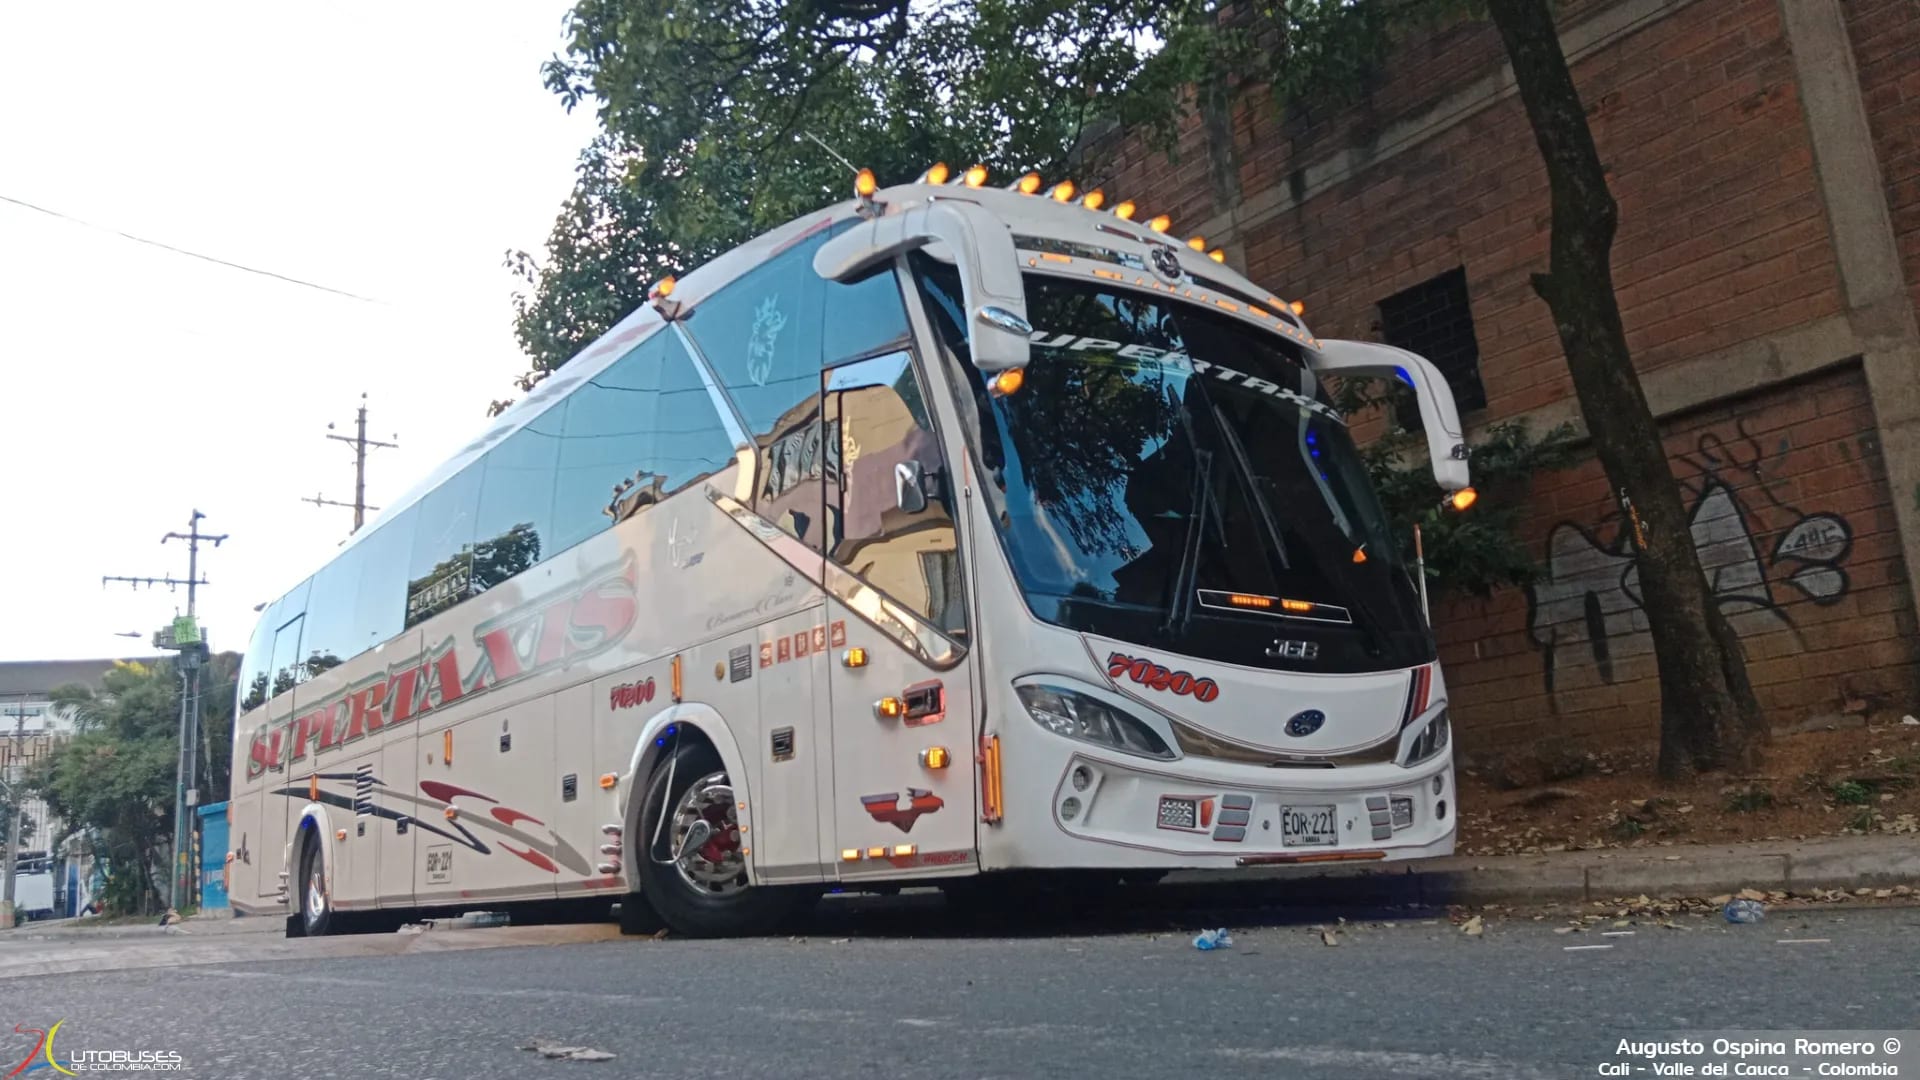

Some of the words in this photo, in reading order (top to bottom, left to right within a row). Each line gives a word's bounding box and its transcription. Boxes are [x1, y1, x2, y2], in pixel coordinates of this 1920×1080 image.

[1029, 330, 1348, 427] UPERTAXIS
[246, 548, 639, 782] SUPERTAXIS
[1108, 651, 1219, 702] 70200
[1265, 639, 1319, 660] JGB
